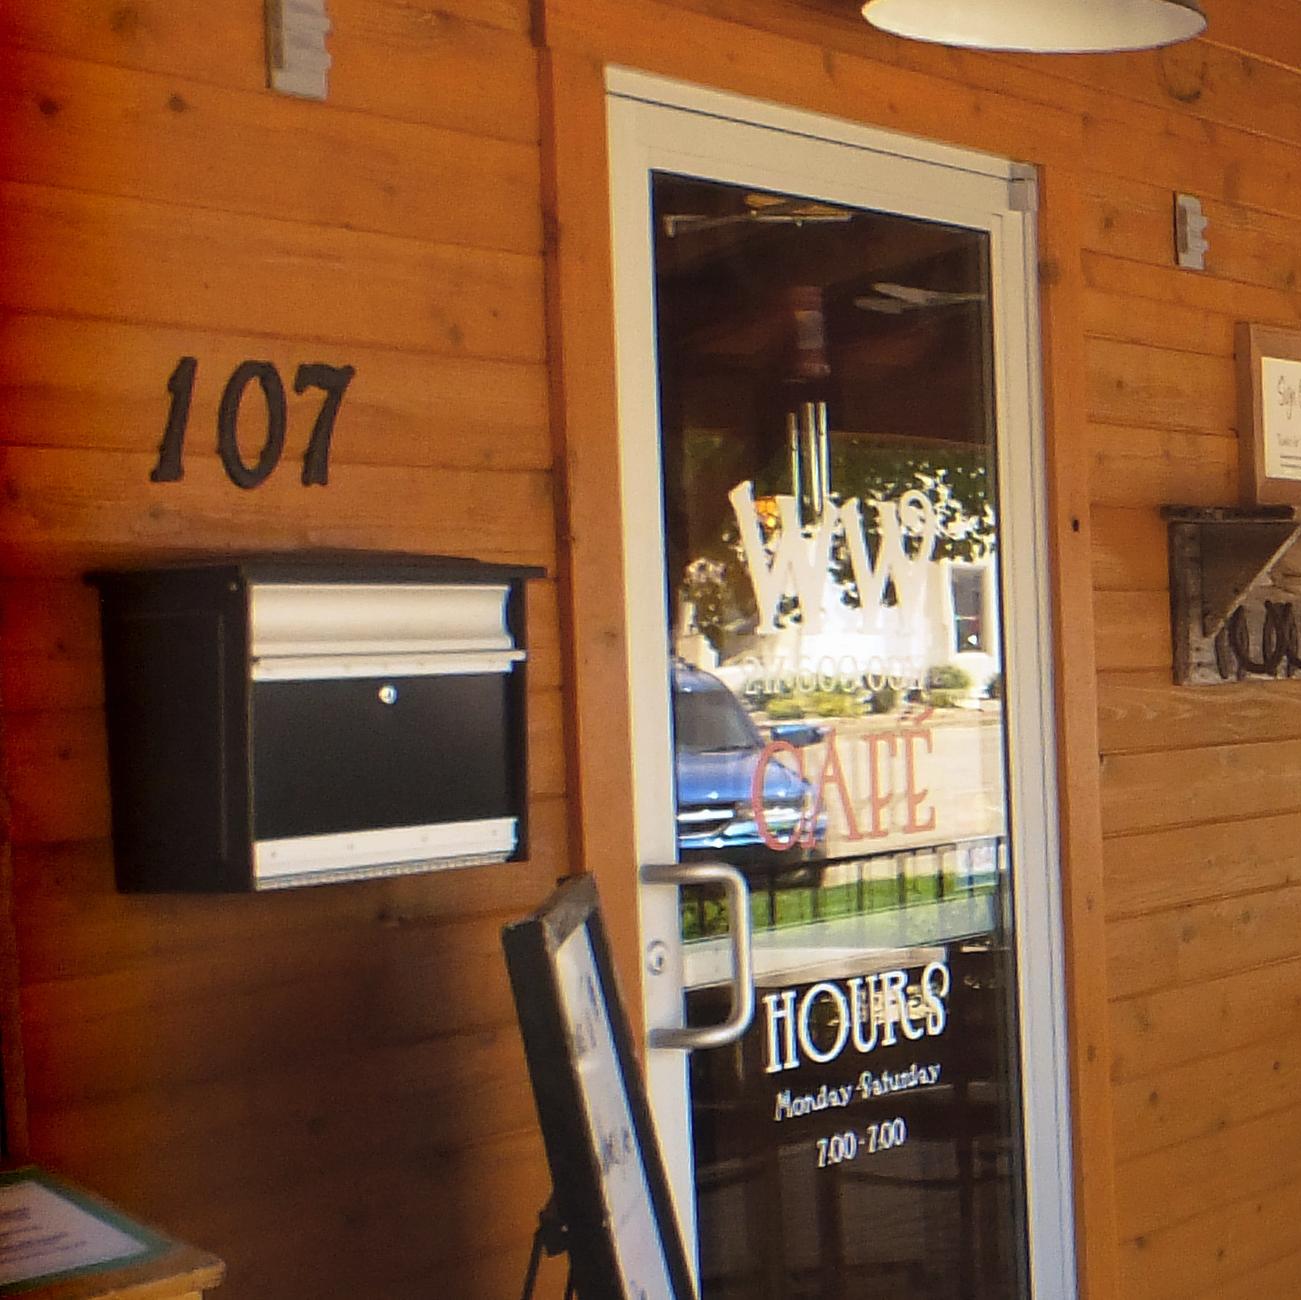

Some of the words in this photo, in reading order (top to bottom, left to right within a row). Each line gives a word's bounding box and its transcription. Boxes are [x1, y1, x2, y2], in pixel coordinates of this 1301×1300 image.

[150, 356, 355, 489] 107
[752, 707, 936, 852] CAFÉ
[762, 961, 951, 1074] HOURS
